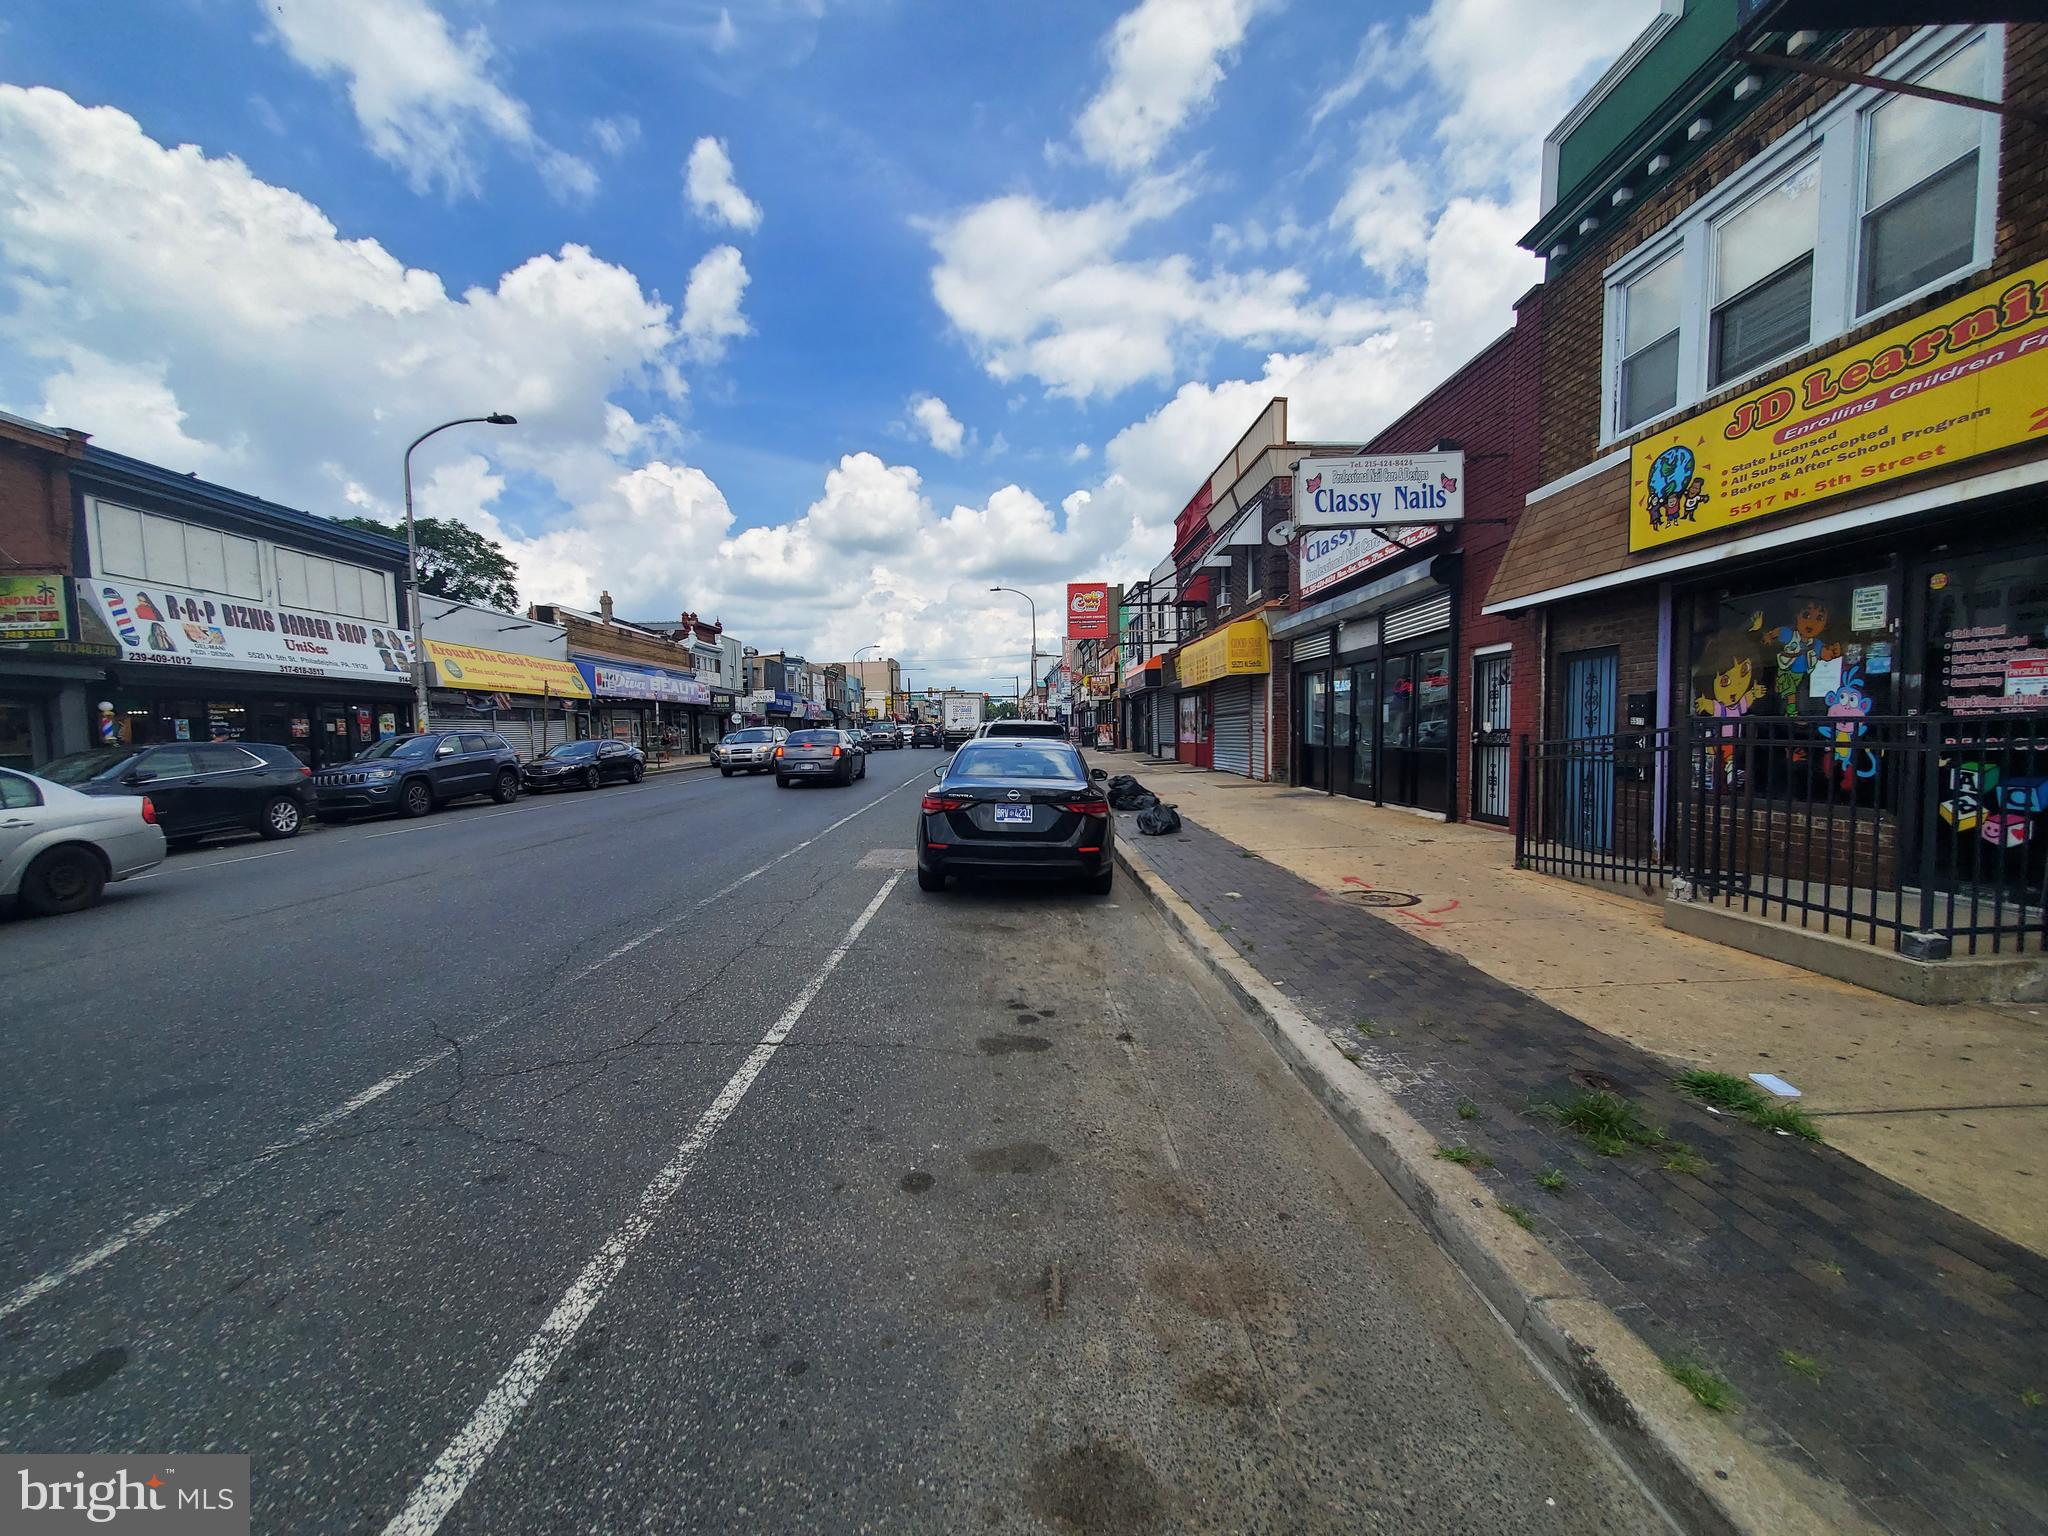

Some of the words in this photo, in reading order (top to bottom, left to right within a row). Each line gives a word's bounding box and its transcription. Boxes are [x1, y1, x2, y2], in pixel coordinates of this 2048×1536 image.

[1724, 386, 1796, 440] JD
[1783, 398, 1879, 441] Enrolling
[1889, 351, 2005, 400] Children
[1364, 459, 1413, 468] 215-424-8424
[1730, 477, 1776, 497] Before
[1780, 471, 1791, 480] &
[1794, 457, 1833, 477] After
[1837, 436, 1896, 462] School
[1901, 407, 1991, 442] Program
[1731, 457, 1766, 474] State
[1769, 429, 1837, 460] Licensed
[1731, 473, 1747, 486] All
[1751, 453, 1807, 479] Subsidy
[1810, 424, 1889, 460] Accepted
[1332, 469, 1369, 484] Professional
[1369, 468, 1383, 482] Nail
[1383, 468, 1397, 482] Care
[1398, 467, 1404, 481] &
[1404, 466, 1430, 484] Designs
[1729, 495, 1777, 517] 5517
[1783, 487, 1806, 501] N.
[1814, 473, 1852, 492] 5th
[1860, 443, 1947, 478] Street
[1314, 487, 1382, 518] Classy
[1394, 482, 1447, 510] Nails
[1307, 528, 1358, 562] Classy
[221, 603, 276, 632] BIZNIS
[278, 612, 334, 641] BARBER
[335, 621, 368, 645] SHOP
[129, 652, 193, 665] 239-409-1012
[247, 651, 266, 660] 5520
[283, 638, 329, 655] UniSex
[431, 643, 475, 660] Around
[474, 650, 497, 663] The
[498, 654, 526, 667] Clock
[526, 658, 578, 674] Supermarket
[615, 674, 647, 691] Diva
[996, 808, 1009, 818] BRV
[1014, 808, 1031, 818] 4231
